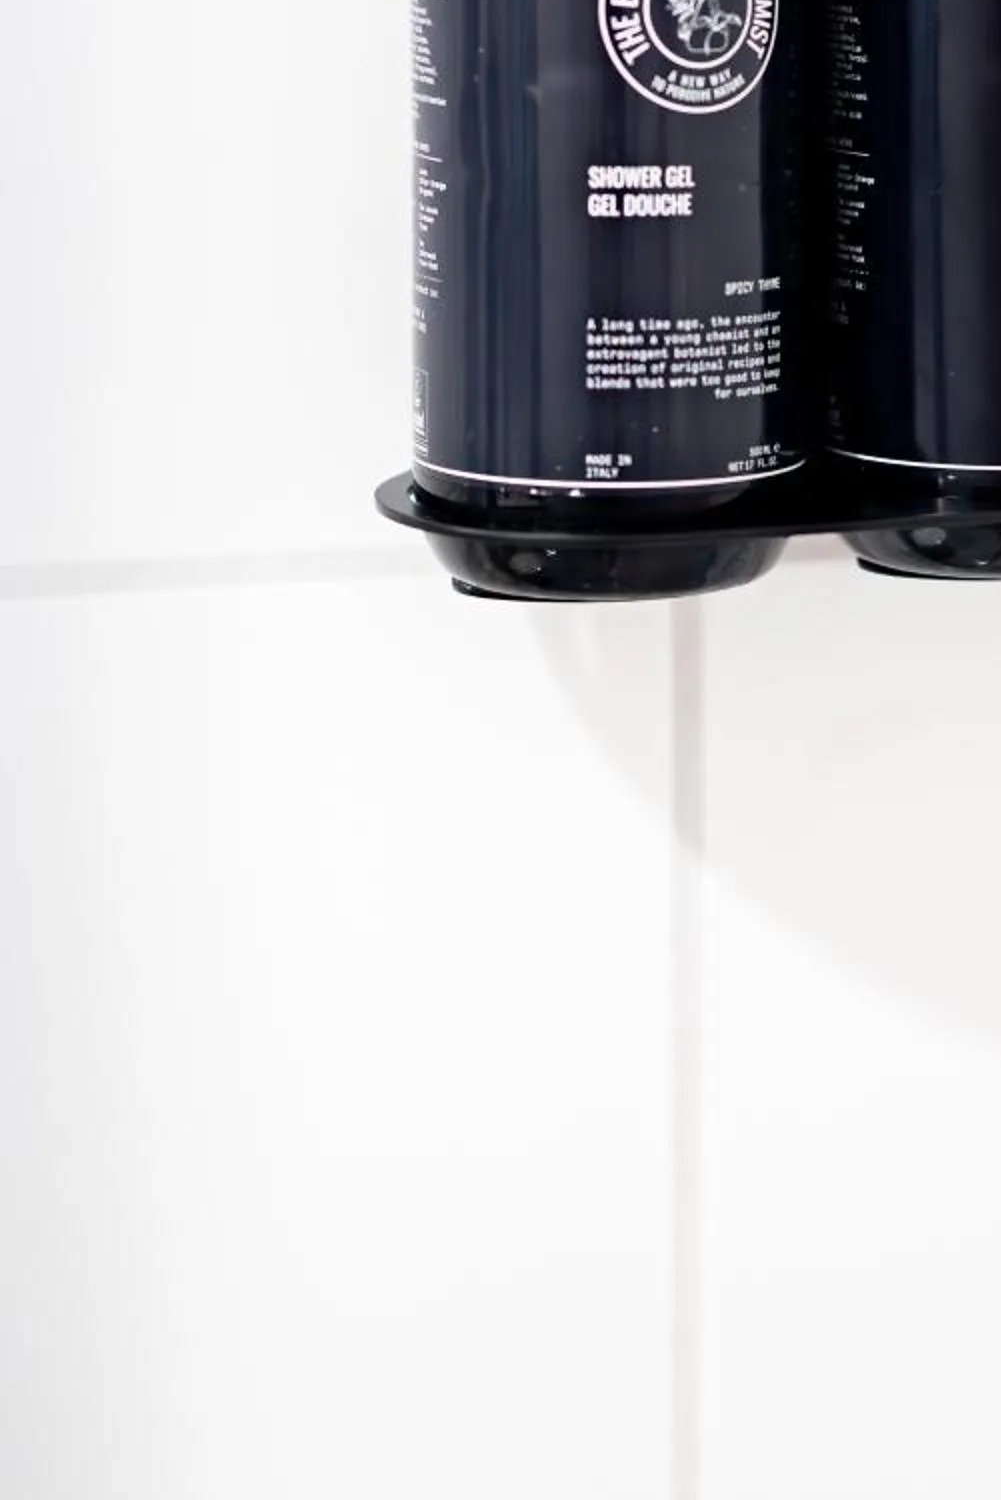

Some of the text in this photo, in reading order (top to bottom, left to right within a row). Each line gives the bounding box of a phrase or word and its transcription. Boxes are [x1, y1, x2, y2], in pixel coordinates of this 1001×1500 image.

[612, 11, 651, 66] THE
[588, 165, 695, 188] SHOWER GEL
[588, 193, 693, 217] GEL DOUCHE
[587, 318, 596, 331] A
[602, 318, 634, 333] long
[640, 318, 671, 331] time
[587, 333, 644, 346] between
[650, 335, 658, 345] a
[664, 332, 701, 346] young
[587, 348, 668, 362] extravagant
[587, 362, 646, 375] creation
[650, 362, 665, 374] of
[587, 376, 630, 389] blends
[636, 376, 664, 389] that
[669, 377, 697, 388] were
[586, 454, 632, 466] MADE IN
[586, 467, 619, 479] ITALY
